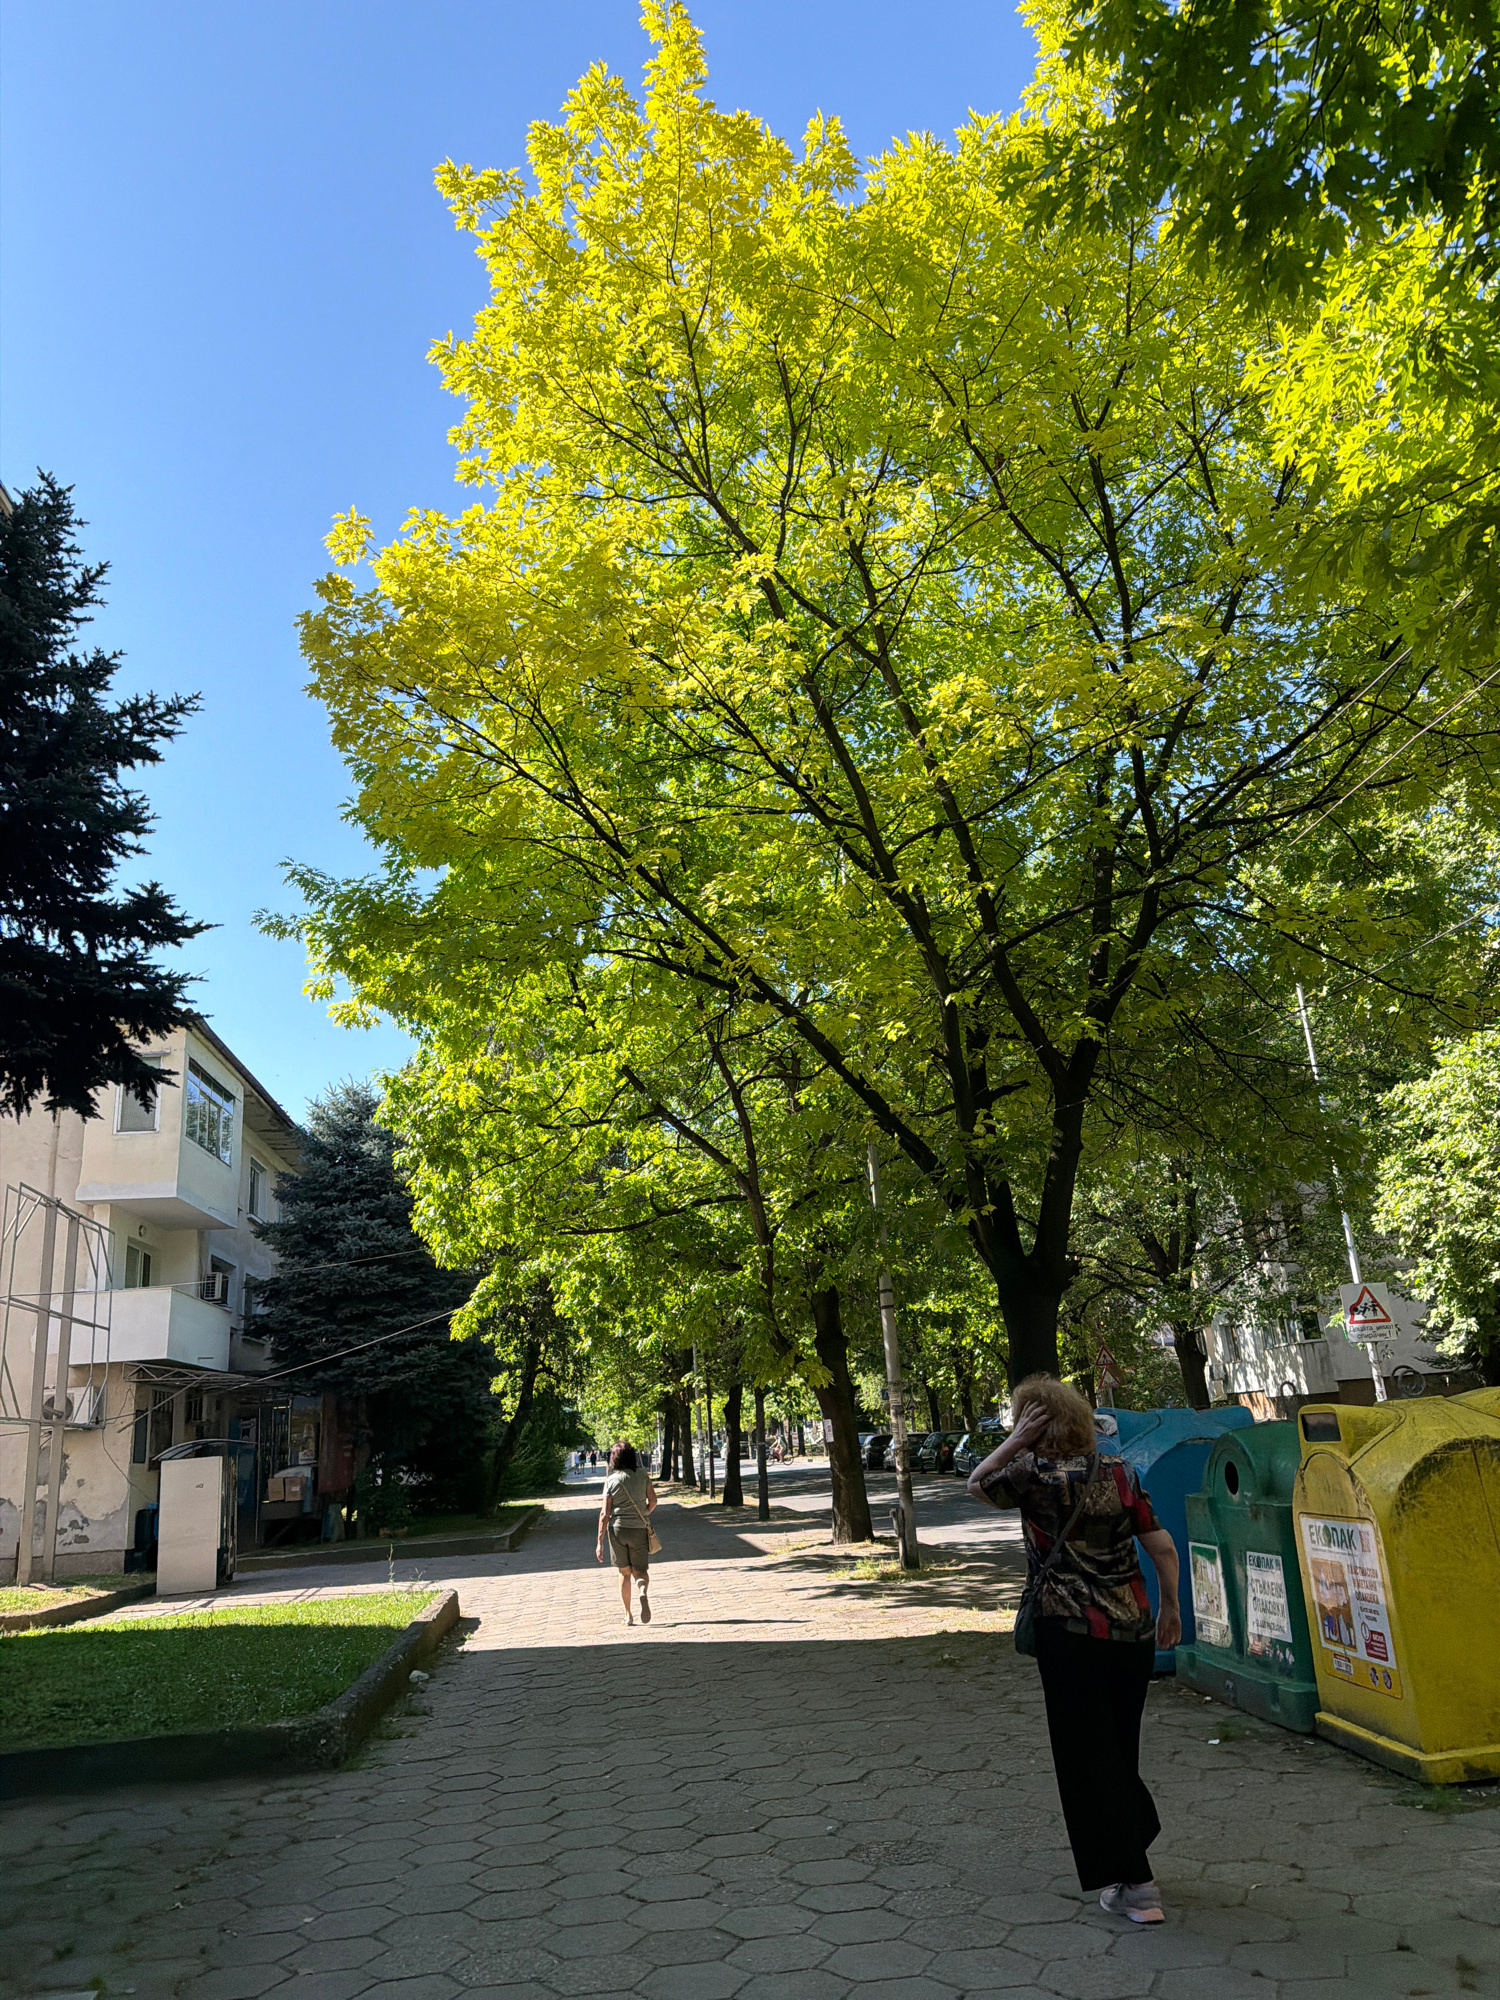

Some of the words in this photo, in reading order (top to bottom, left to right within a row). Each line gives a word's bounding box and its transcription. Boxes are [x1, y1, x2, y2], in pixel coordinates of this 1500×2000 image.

[1309, 1524, 1356, 1550] ЕКОПАК
[1248, 1555, 1274, 1570] ЕКОПАК
[1250, 1578, 1284, 1599] СТЪКЛЕНИ
[1253, 1597, 1286, 1618] ОПАКОВКИ
